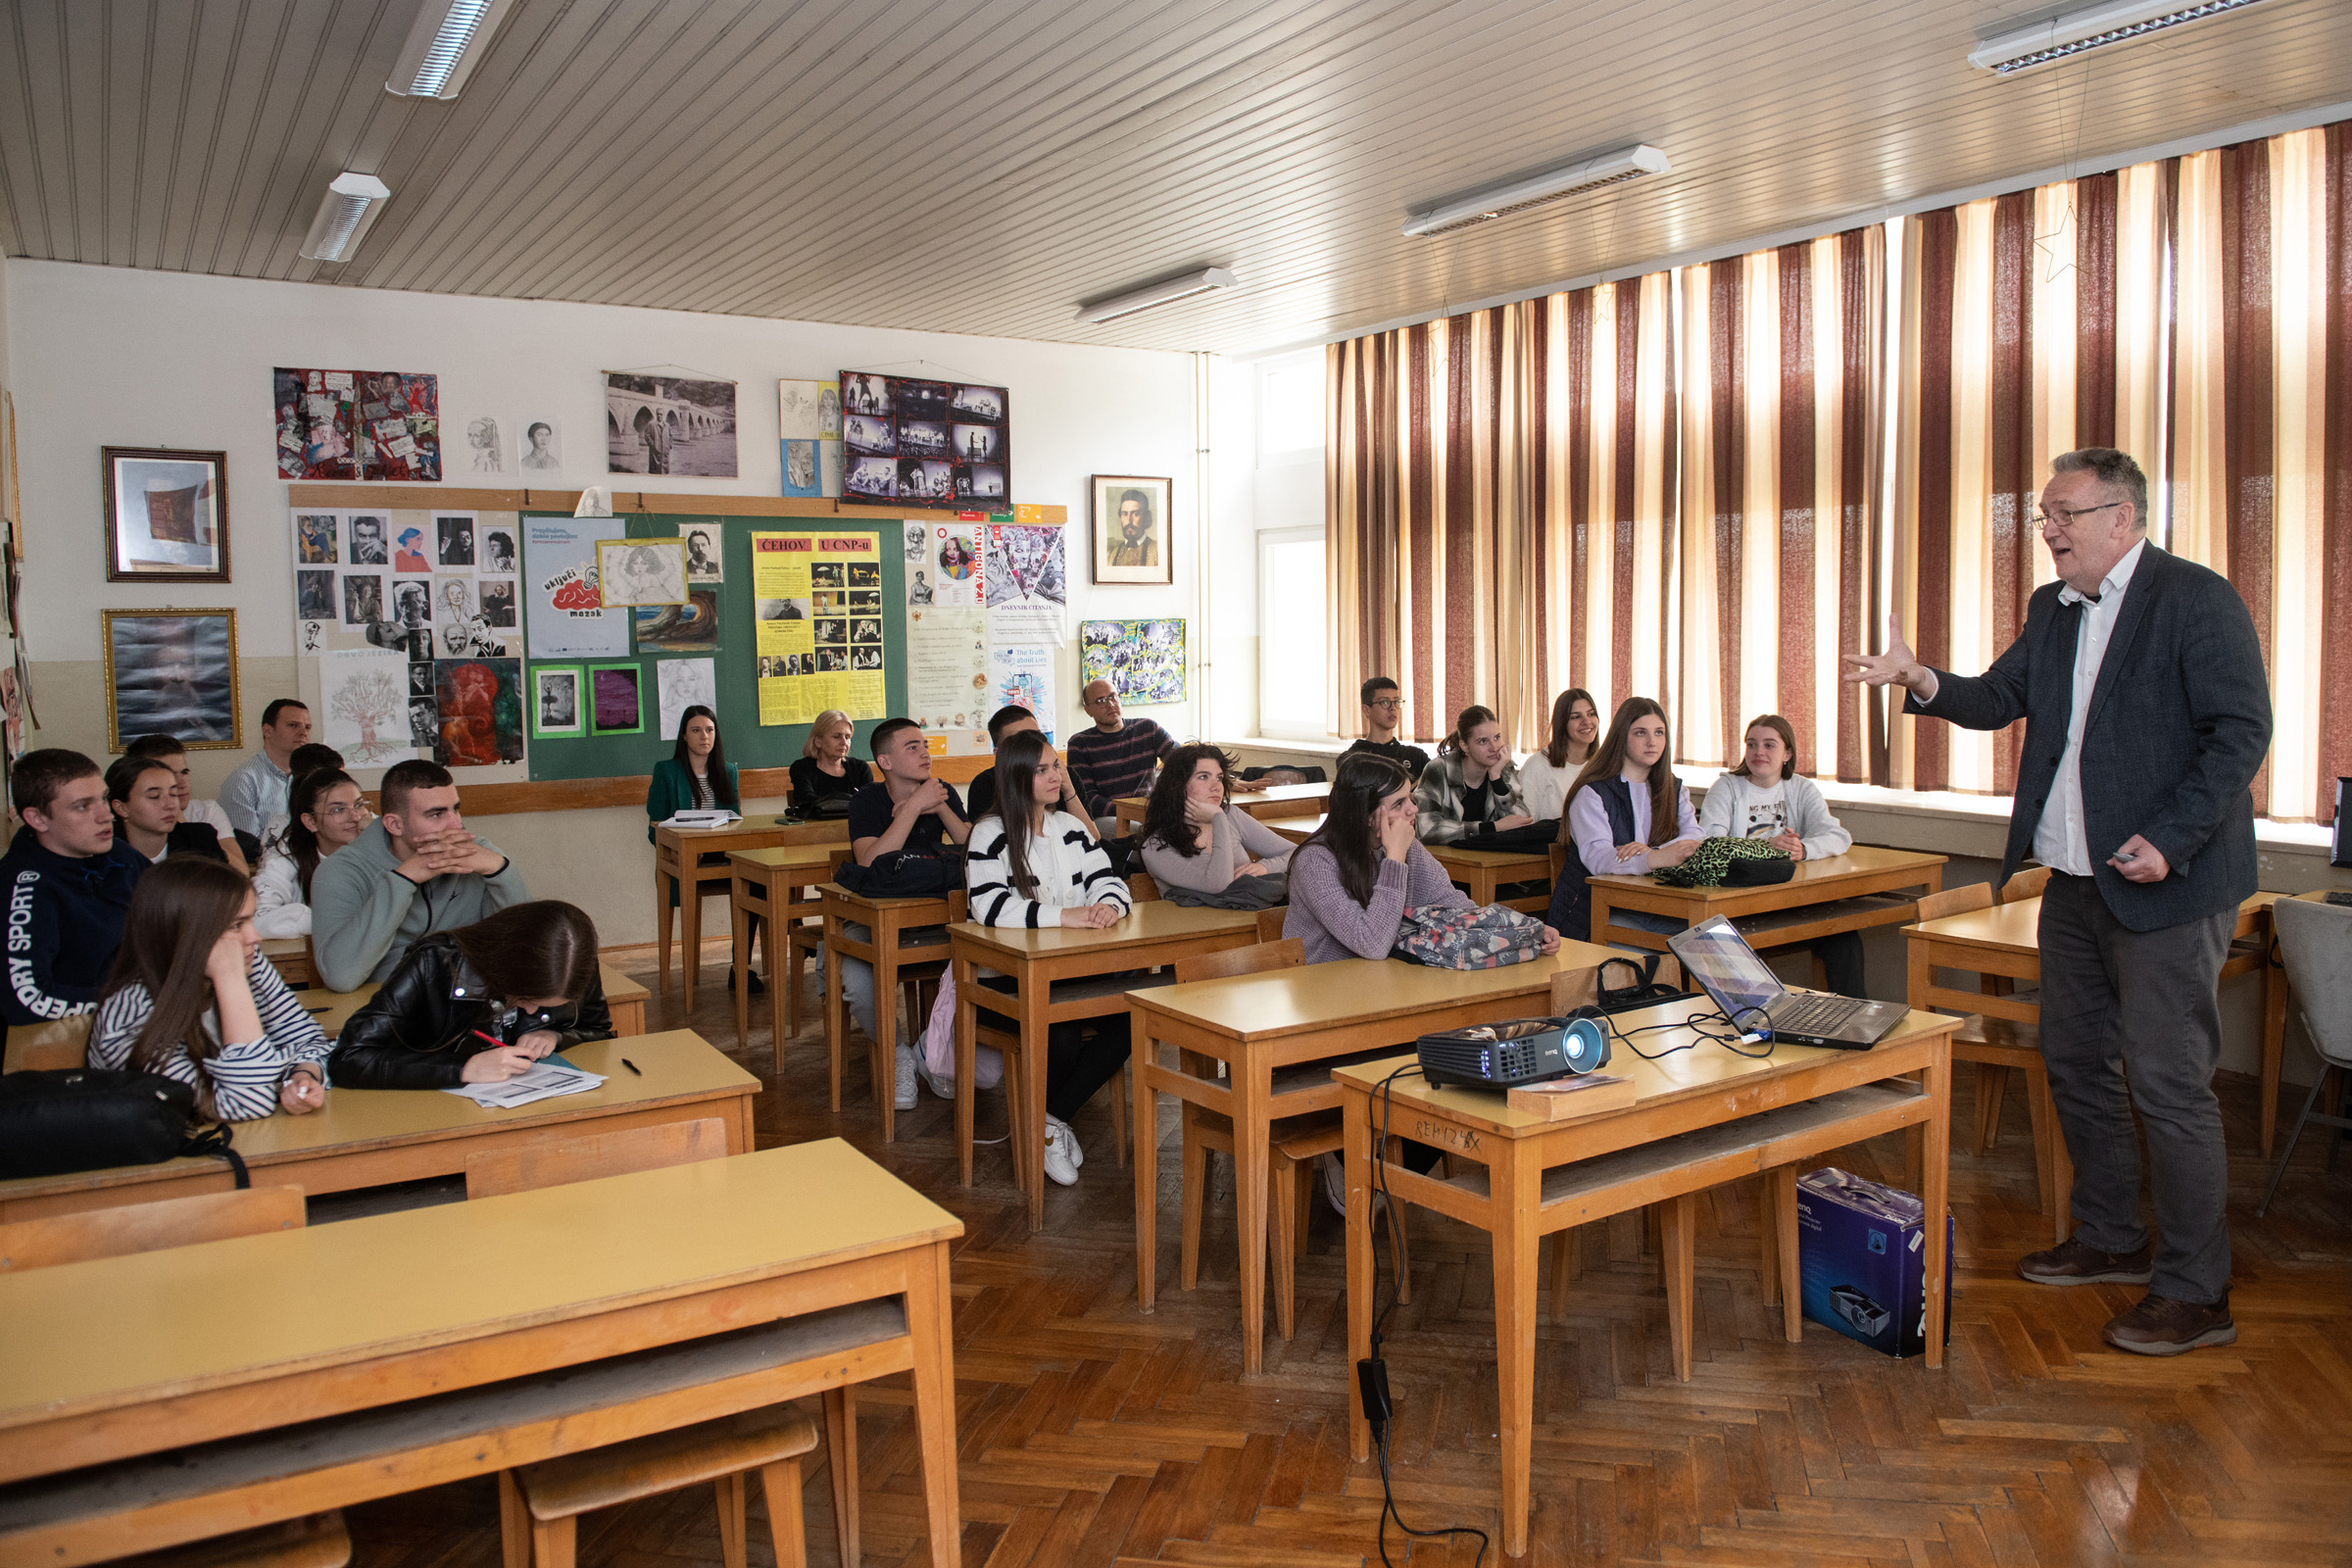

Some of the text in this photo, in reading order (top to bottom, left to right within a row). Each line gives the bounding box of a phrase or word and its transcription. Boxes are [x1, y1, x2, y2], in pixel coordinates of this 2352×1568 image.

[761, 538, 807, 551] ČEHOV
[821, 540, 869, 550] U CNP-u
[974, 526, 984, 585] ANTIGONA
[544, 568, 577, 591] uključi
[8, 956, 99, 1020] UPERDRY
[1797, 1202, 1812, 1215] enQ
